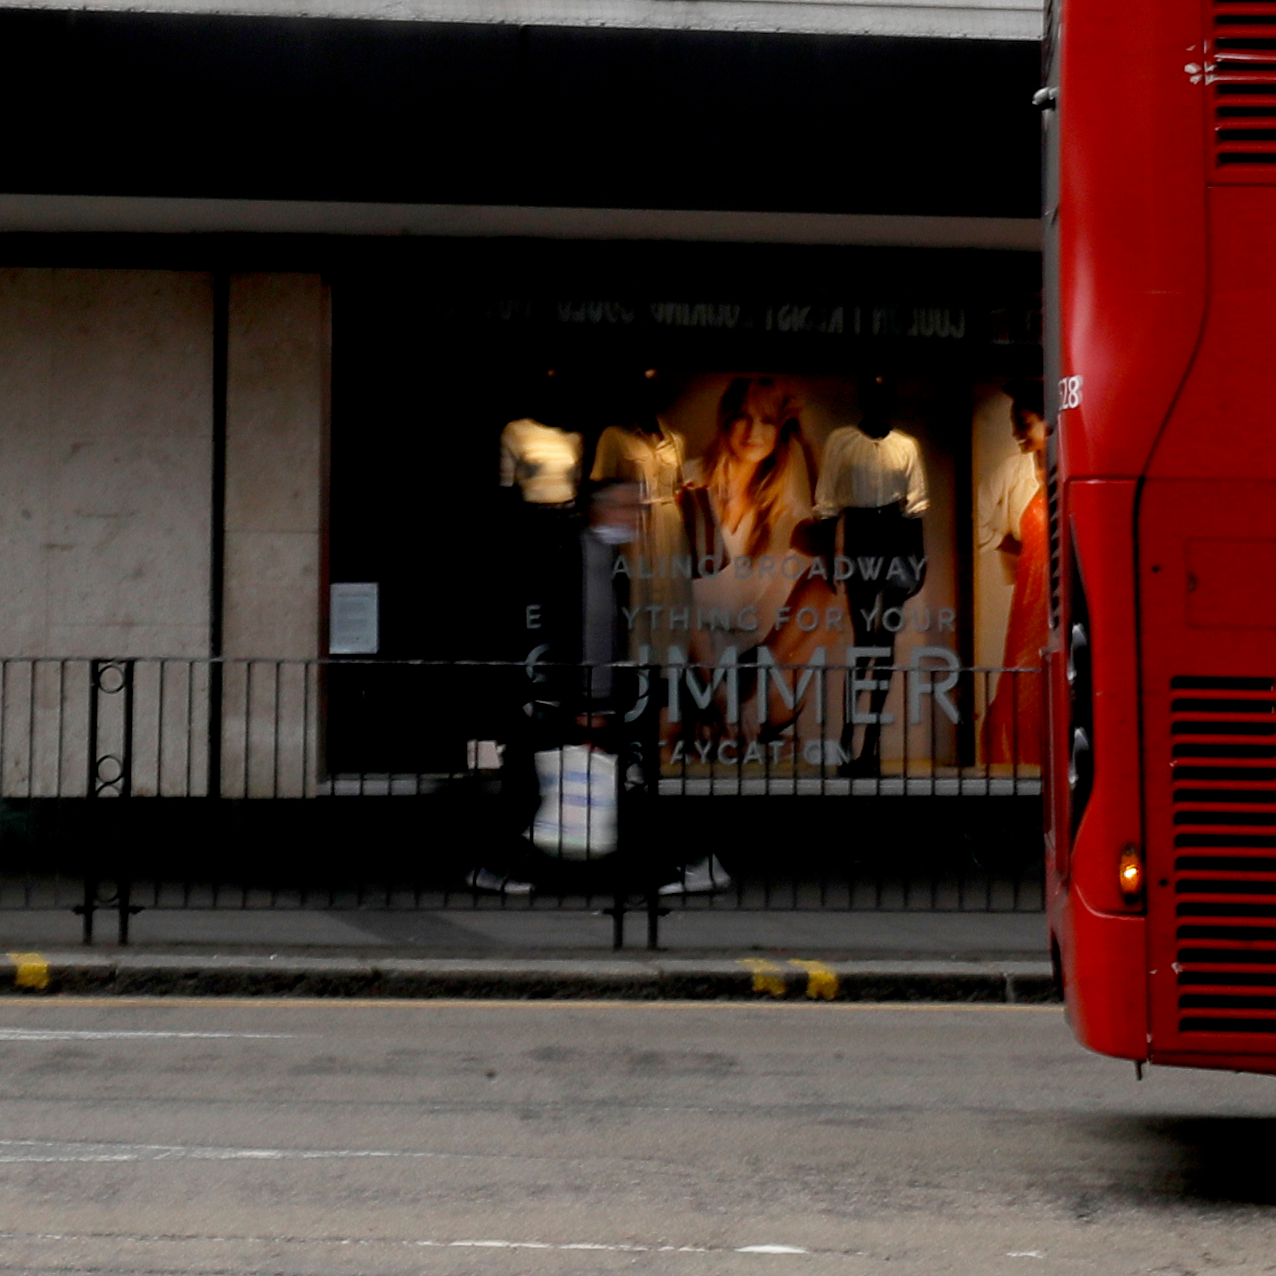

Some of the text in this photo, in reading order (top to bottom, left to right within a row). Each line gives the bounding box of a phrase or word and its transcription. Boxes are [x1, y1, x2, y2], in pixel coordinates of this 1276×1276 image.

[734, 555, 928, 581] BROADWAY
[774, 606, 844, 632] FOR
[860, 606, 957, 633] YOUR
